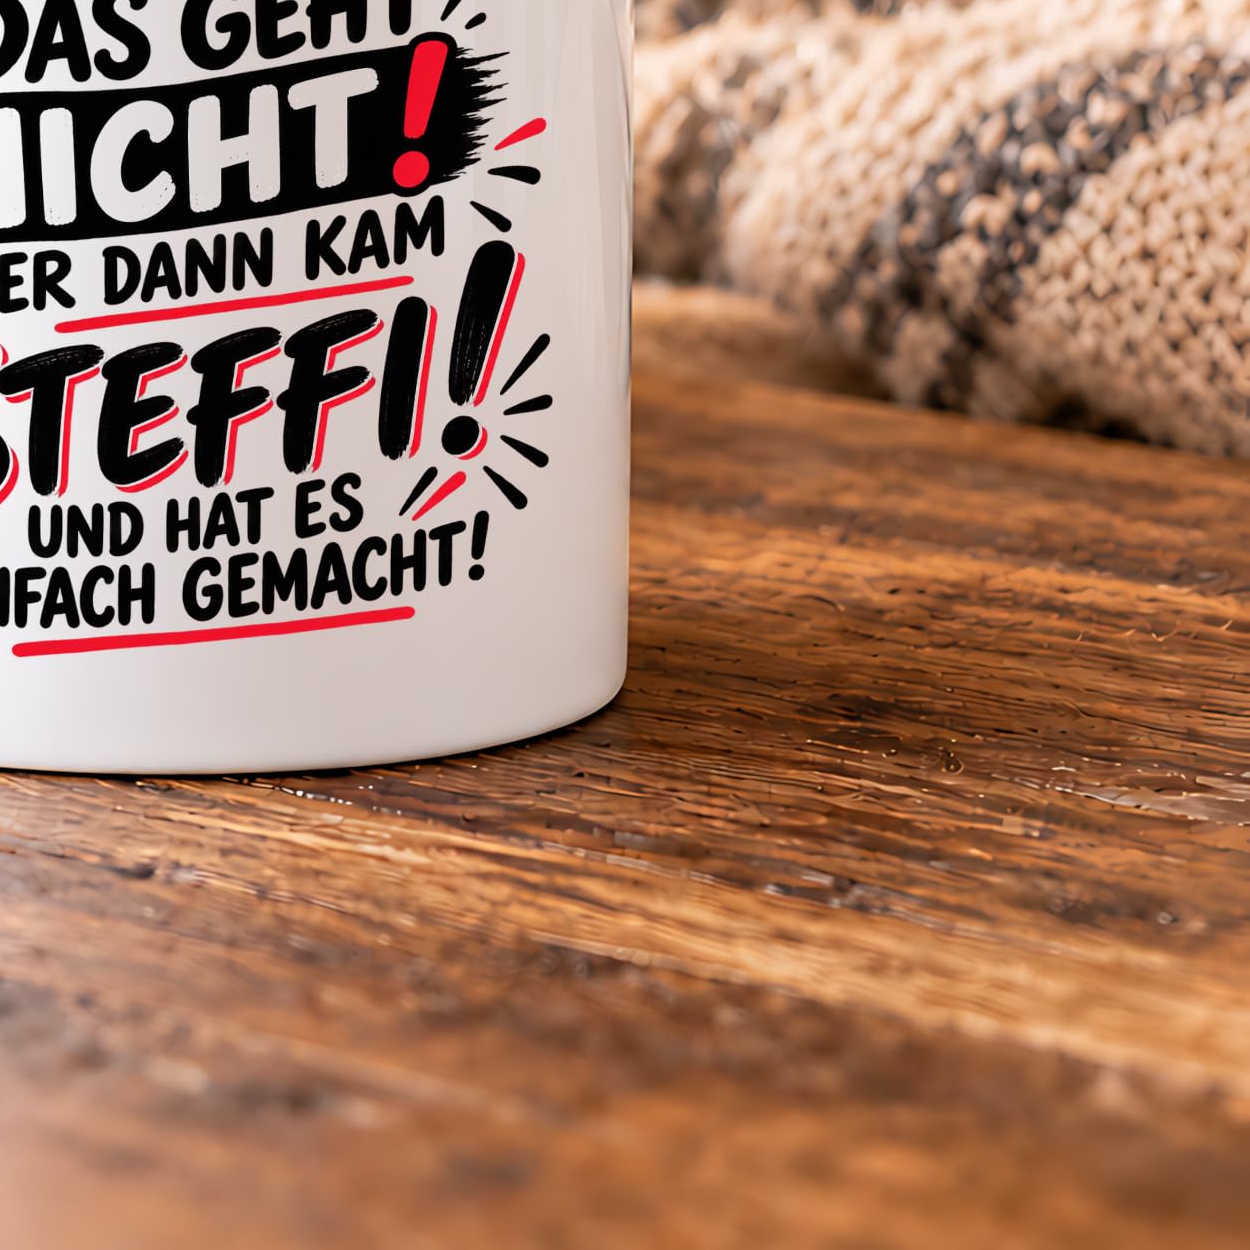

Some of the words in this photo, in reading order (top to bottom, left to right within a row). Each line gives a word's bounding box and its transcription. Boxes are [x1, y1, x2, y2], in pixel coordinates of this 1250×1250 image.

[103, 227, 274, 304] DANN
[305, 196, 445, 282] KAM
[27, 502, 144, 559] UND
[165, 487, 275, 551] HAT
[295, 473, 365, 538] ES
[181, 510, 489, 622] GEMACHT!
